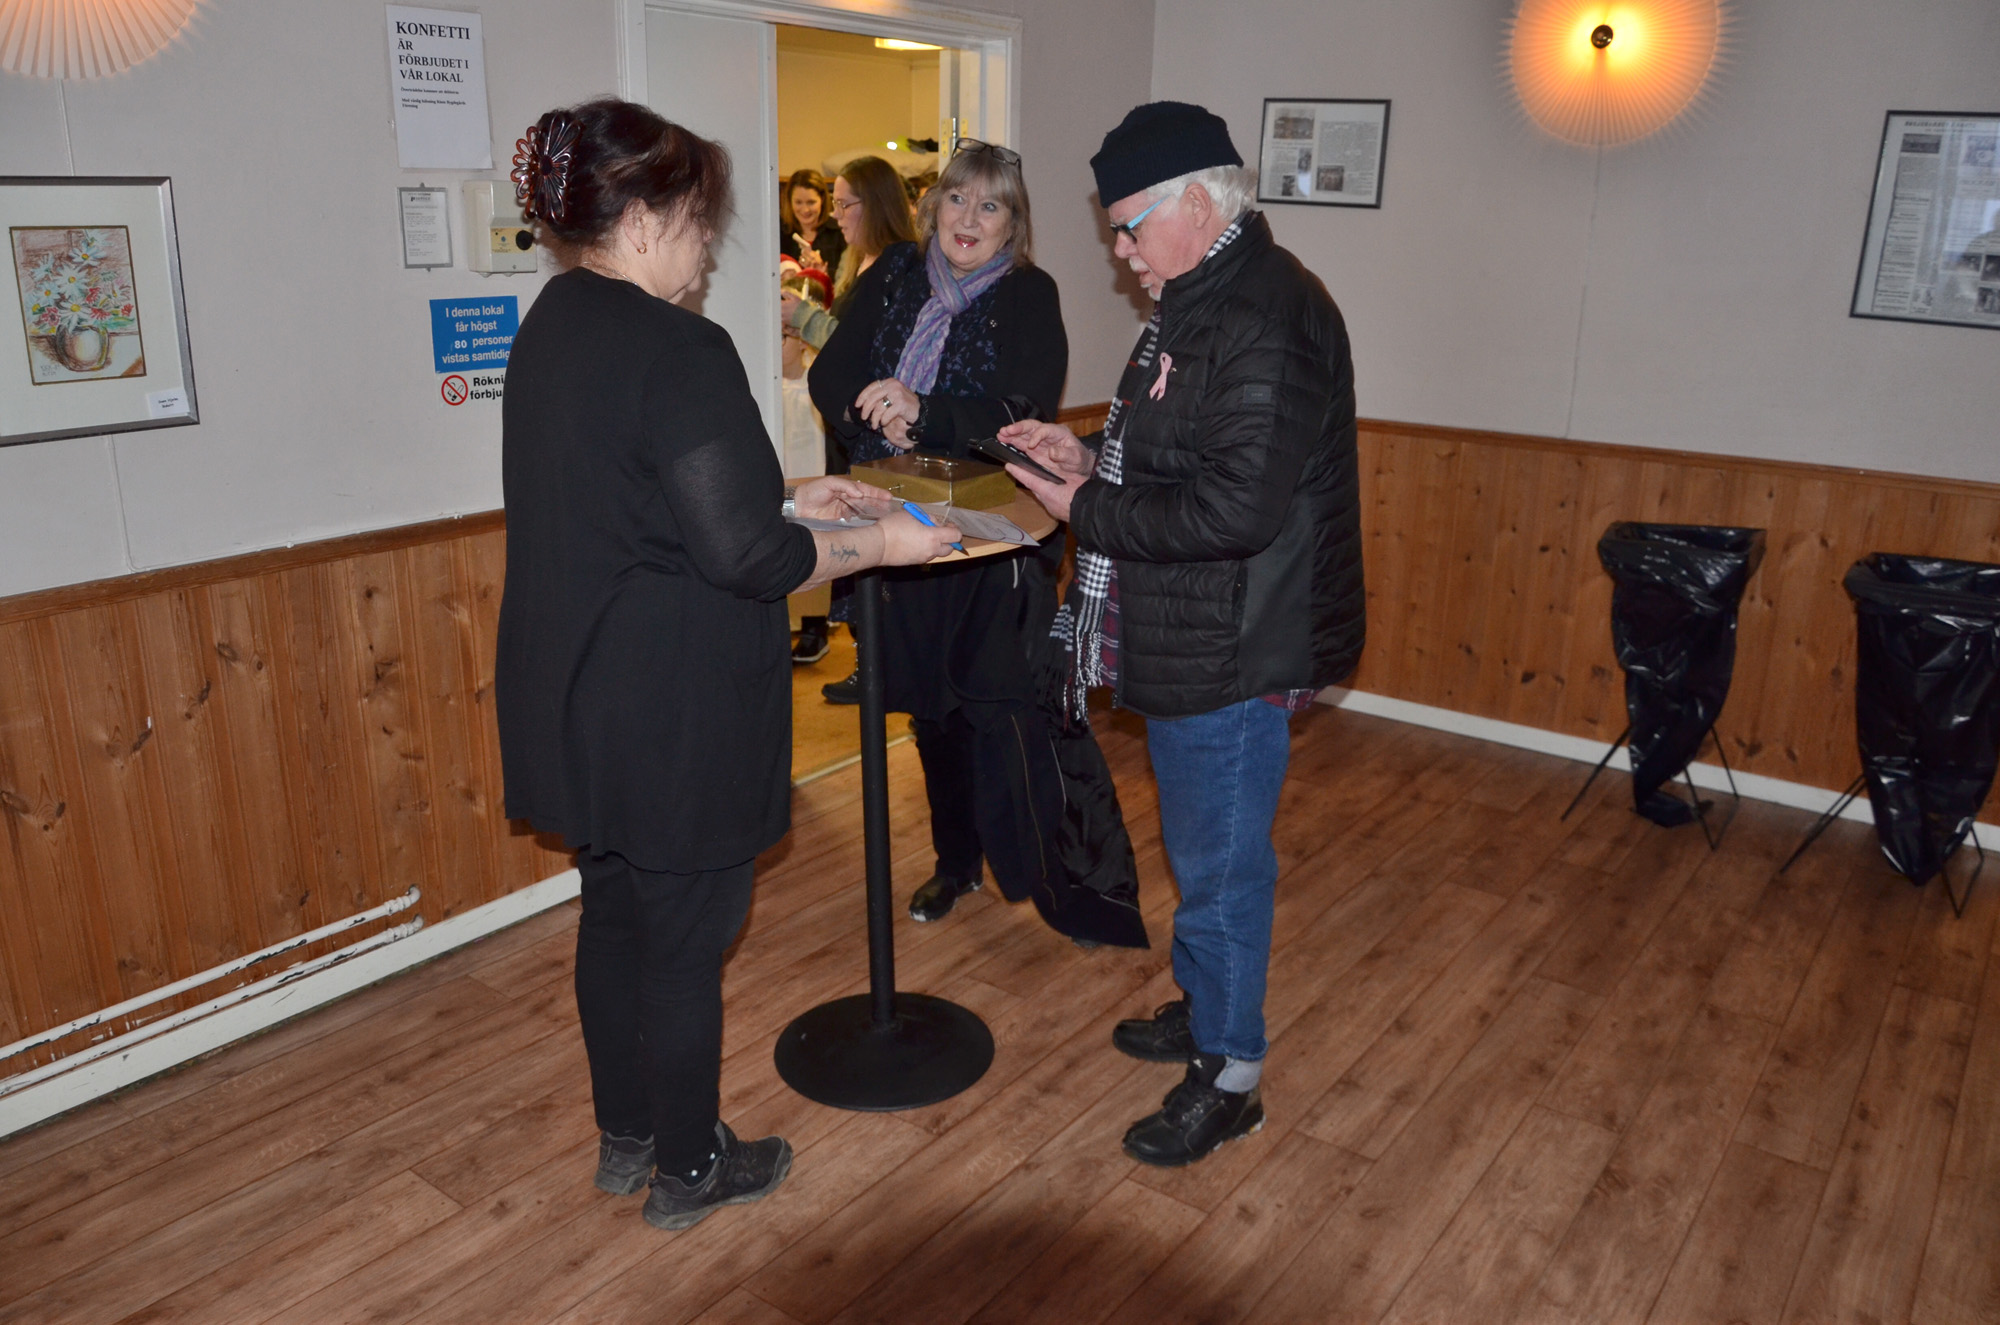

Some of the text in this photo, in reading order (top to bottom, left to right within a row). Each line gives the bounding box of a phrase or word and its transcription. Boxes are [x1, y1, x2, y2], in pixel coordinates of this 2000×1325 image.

[396, 21, 470, 39] KONFETTI
[398, 38, 413, 50] ÄR
[399, 53, 469, 69] FÖRBJUDET I
[400, 68, 463, 82] VÅR LOKAL
[445, 304, 504, 318] I denna lokal
[455, 320, 497, 332] får högst
[454, 336, 513, 349] 80 personer
[442, 349, 510, 363] vistas samtidig
[473, 375, 504, 386] Rökni
[470, 388, 503, 400] förbju
